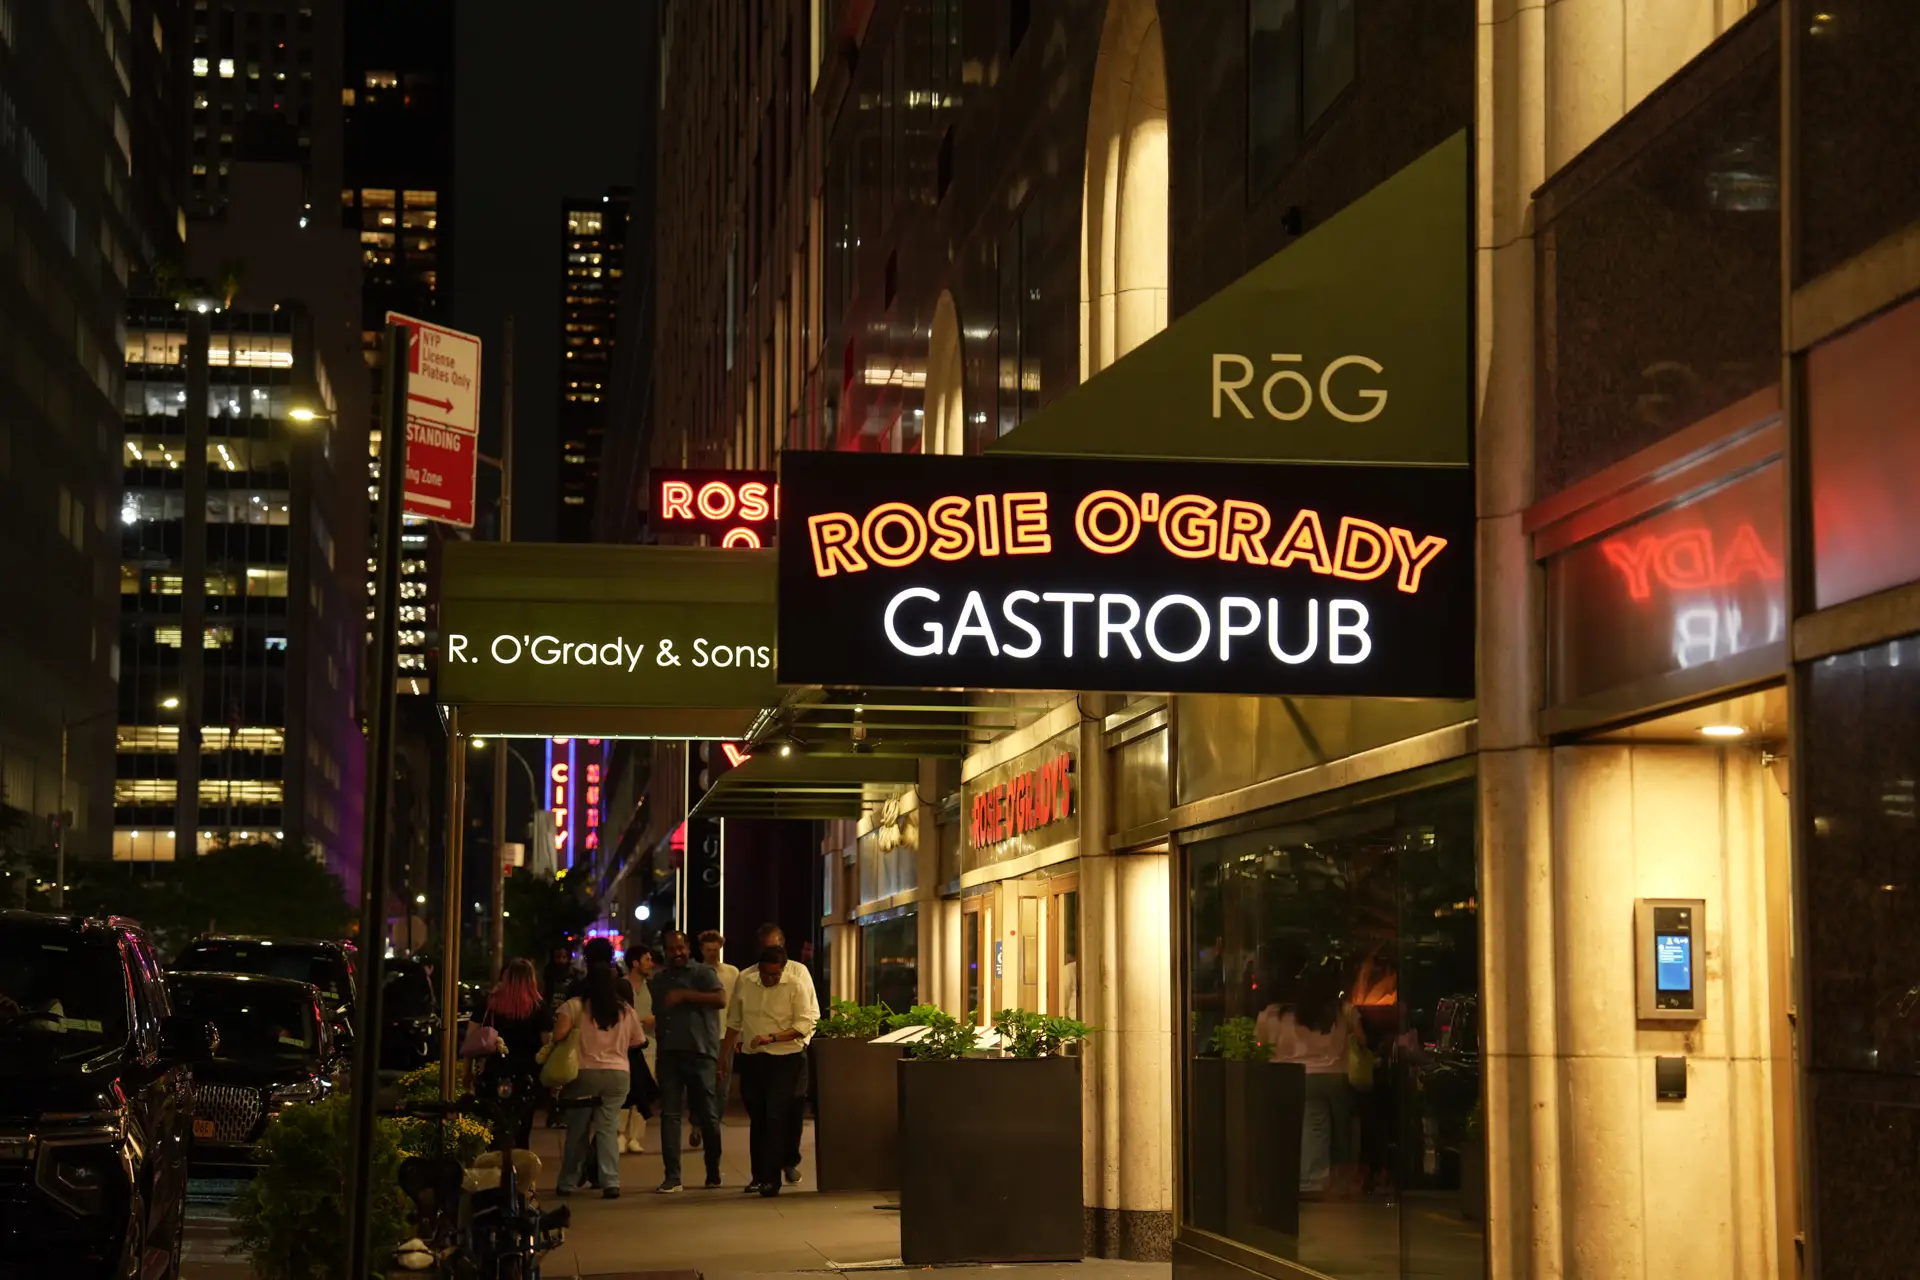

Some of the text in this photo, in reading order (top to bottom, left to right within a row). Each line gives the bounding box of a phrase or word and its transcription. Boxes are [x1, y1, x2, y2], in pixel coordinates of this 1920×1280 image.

[423, 331, 441, 347] NYP
[423, 347, 455, 369] License
[422, 362, 471, 391] Plates Only
[406, 423, 461, 453] STANDING
[405, 464, 443, 487] ing Zone
[808, 489, 1448, 593] ROSIE O'GRADY
[884, 587, 1372, 664] GASTROPUB
[448, 634, 770, 673] R. O'Grady & Sons
[551, 763, 569, 849] CITY
[972, 752, 1070, 849] ROSIE O'GRADY'S
